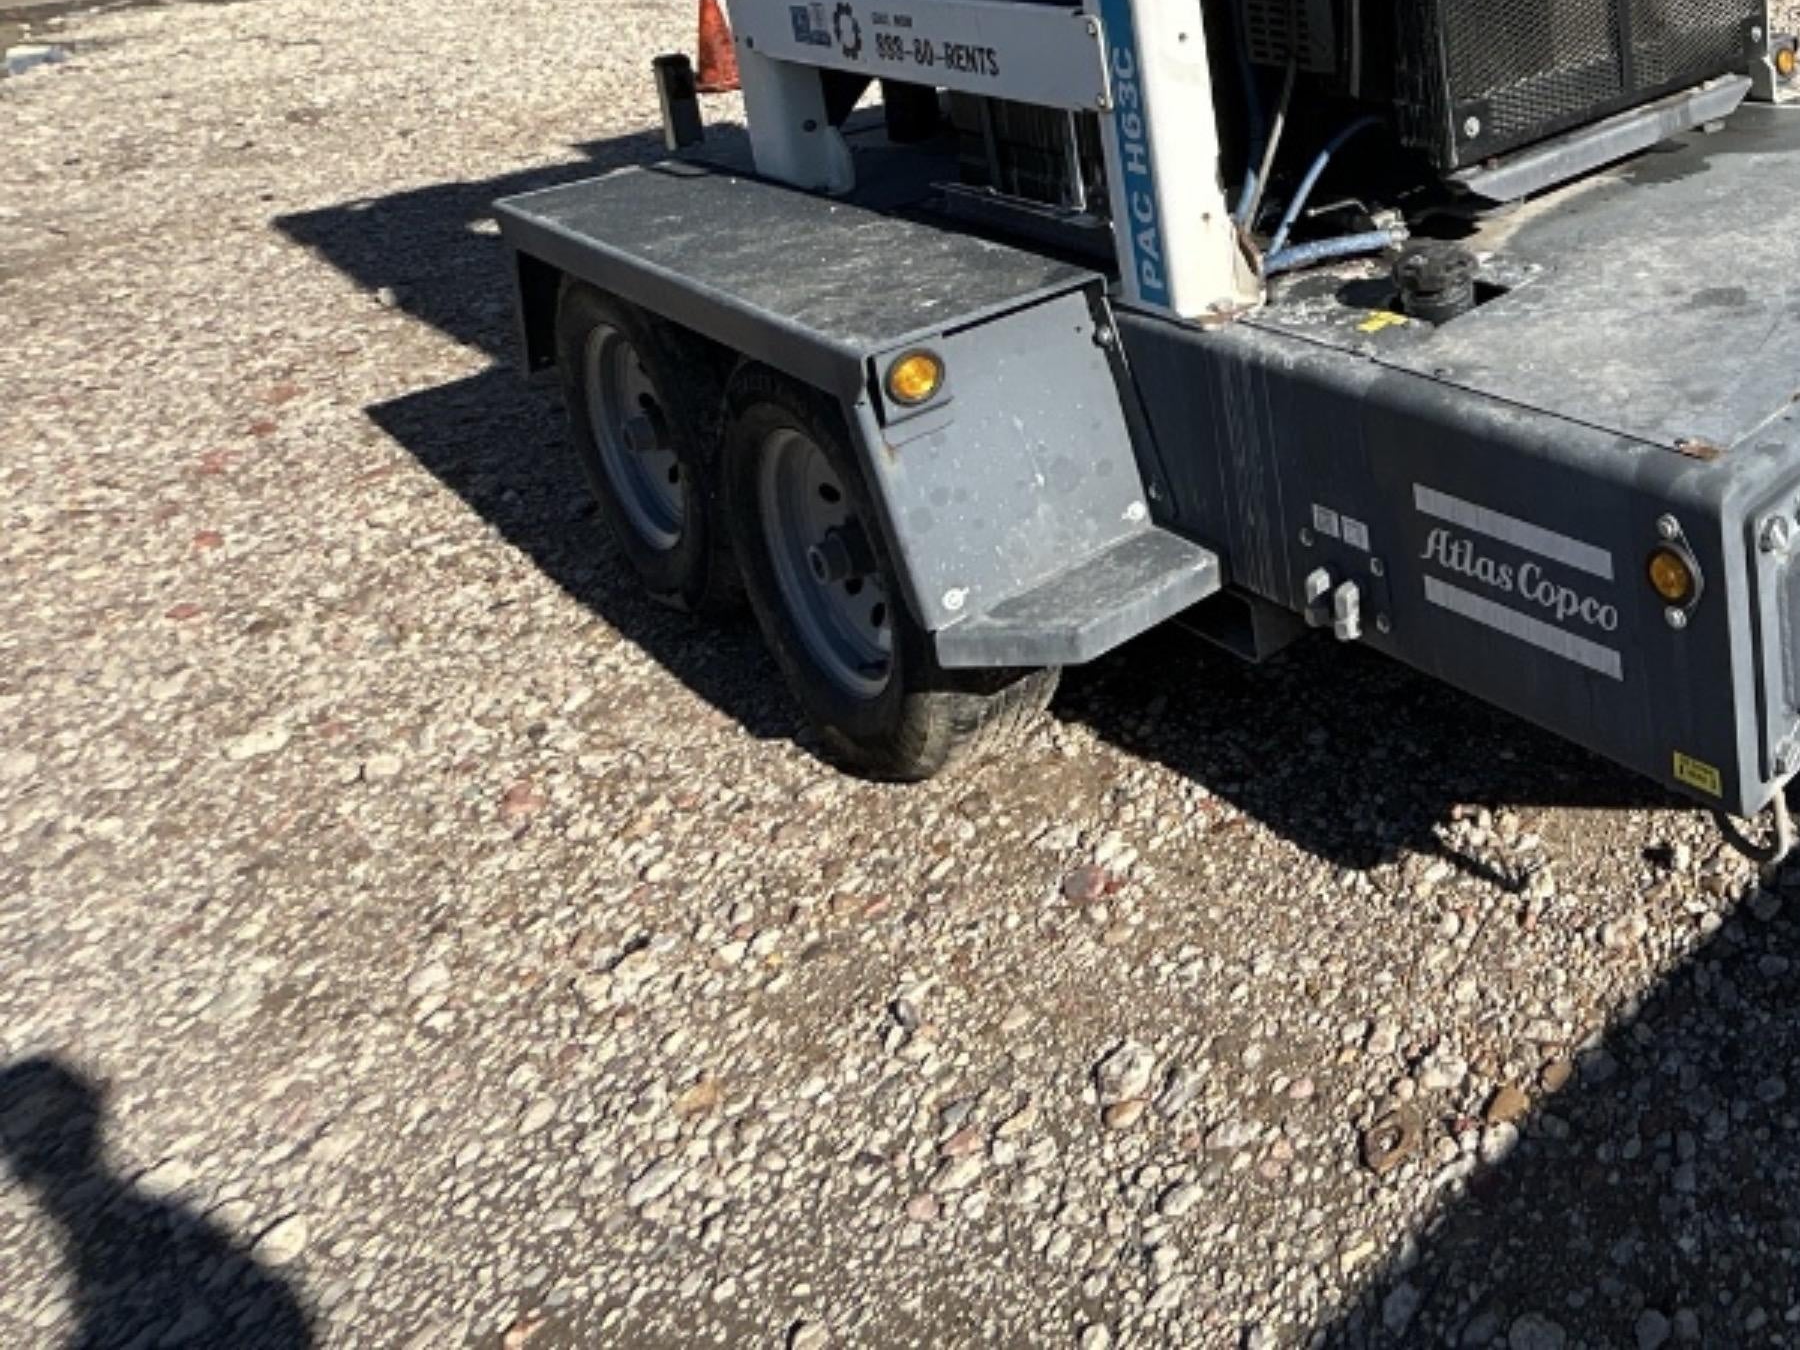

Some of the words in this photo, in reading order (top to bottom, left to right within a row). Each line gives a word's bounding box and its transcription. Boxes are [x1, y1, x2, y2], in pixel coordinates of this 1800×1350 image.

[1112, 46, 1148, 176] H63C
[1132, 191, 1163, 290] PAC
[1419, 526, 1515, 592] Atlas
[1516, 561, 1619, 632] Copco
